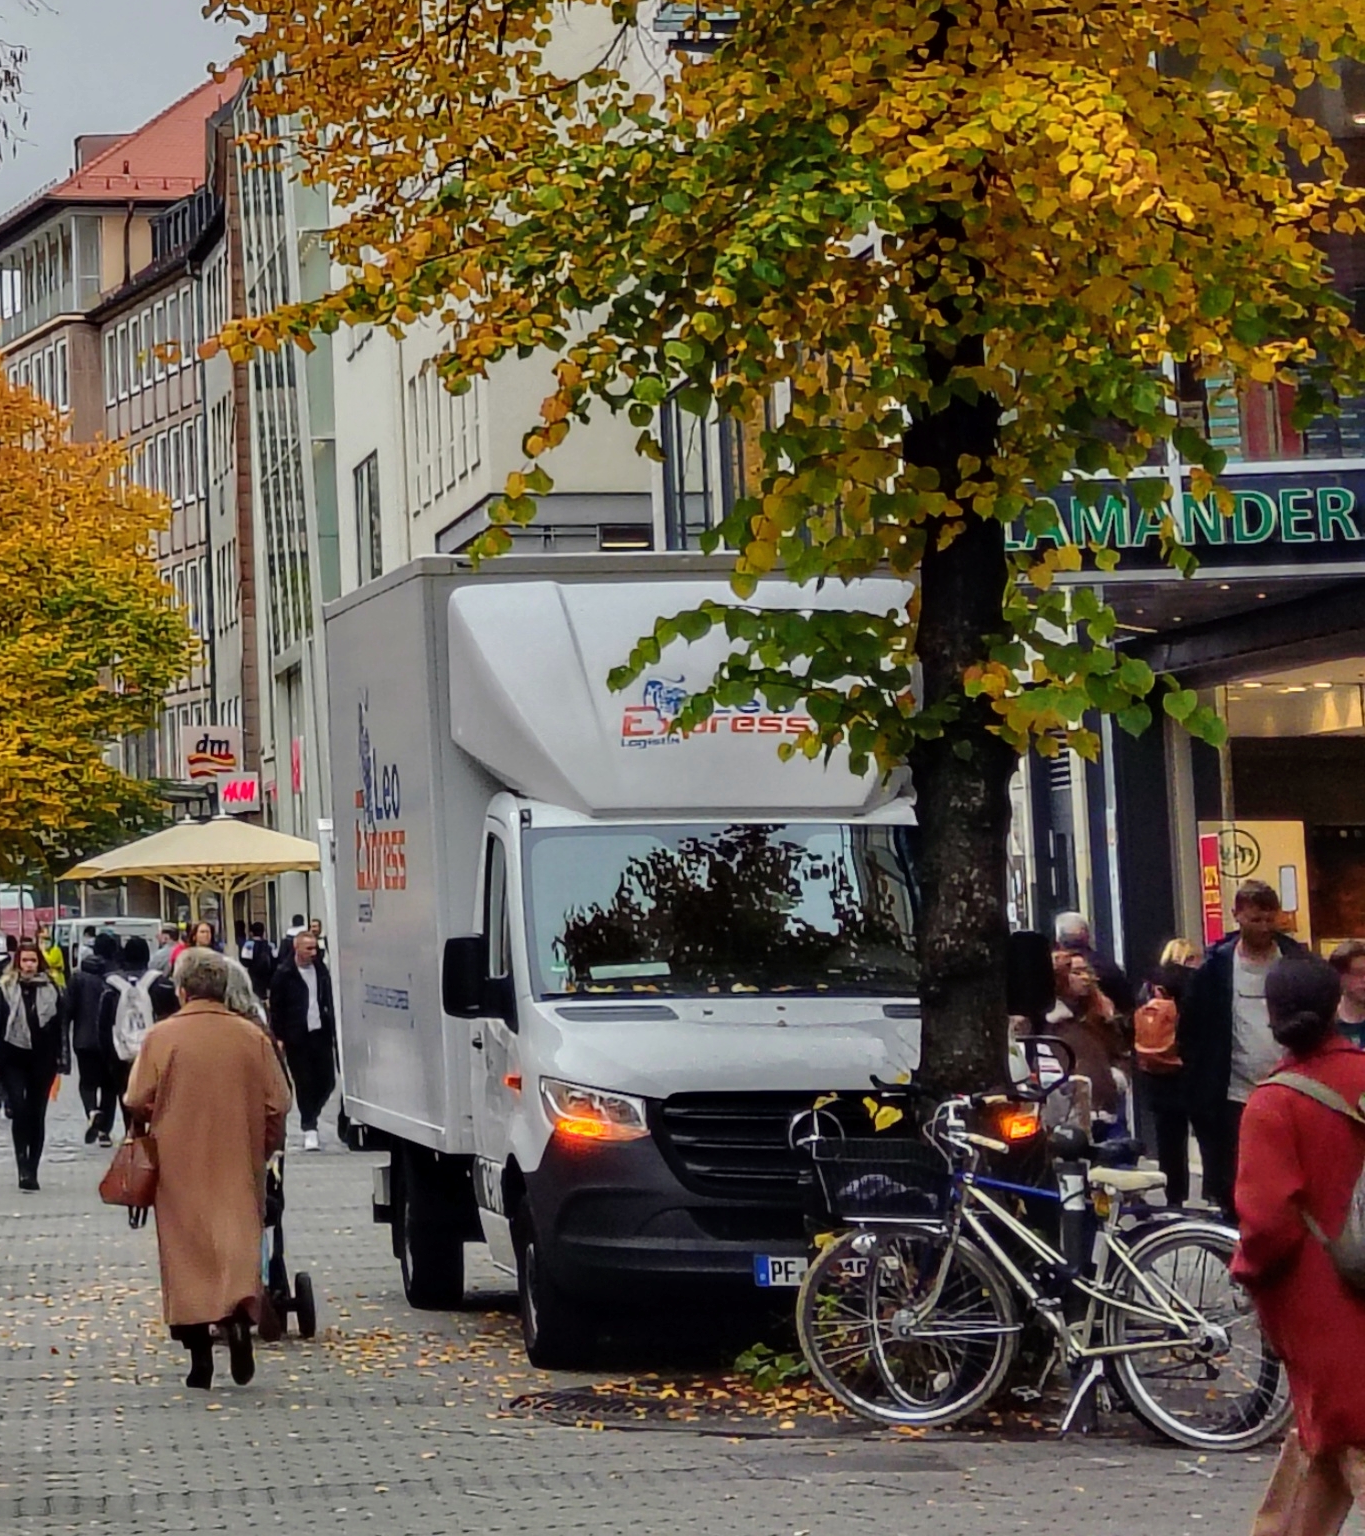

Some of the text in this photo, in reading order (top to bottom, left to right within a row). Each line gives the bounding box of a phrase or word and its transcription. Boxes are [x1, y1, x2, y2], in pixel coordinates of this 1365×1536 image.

[195, 733, 230, 755] dm
[372, 747, 401, 821] Leo
[770, 1260, 797, 1283] PF
